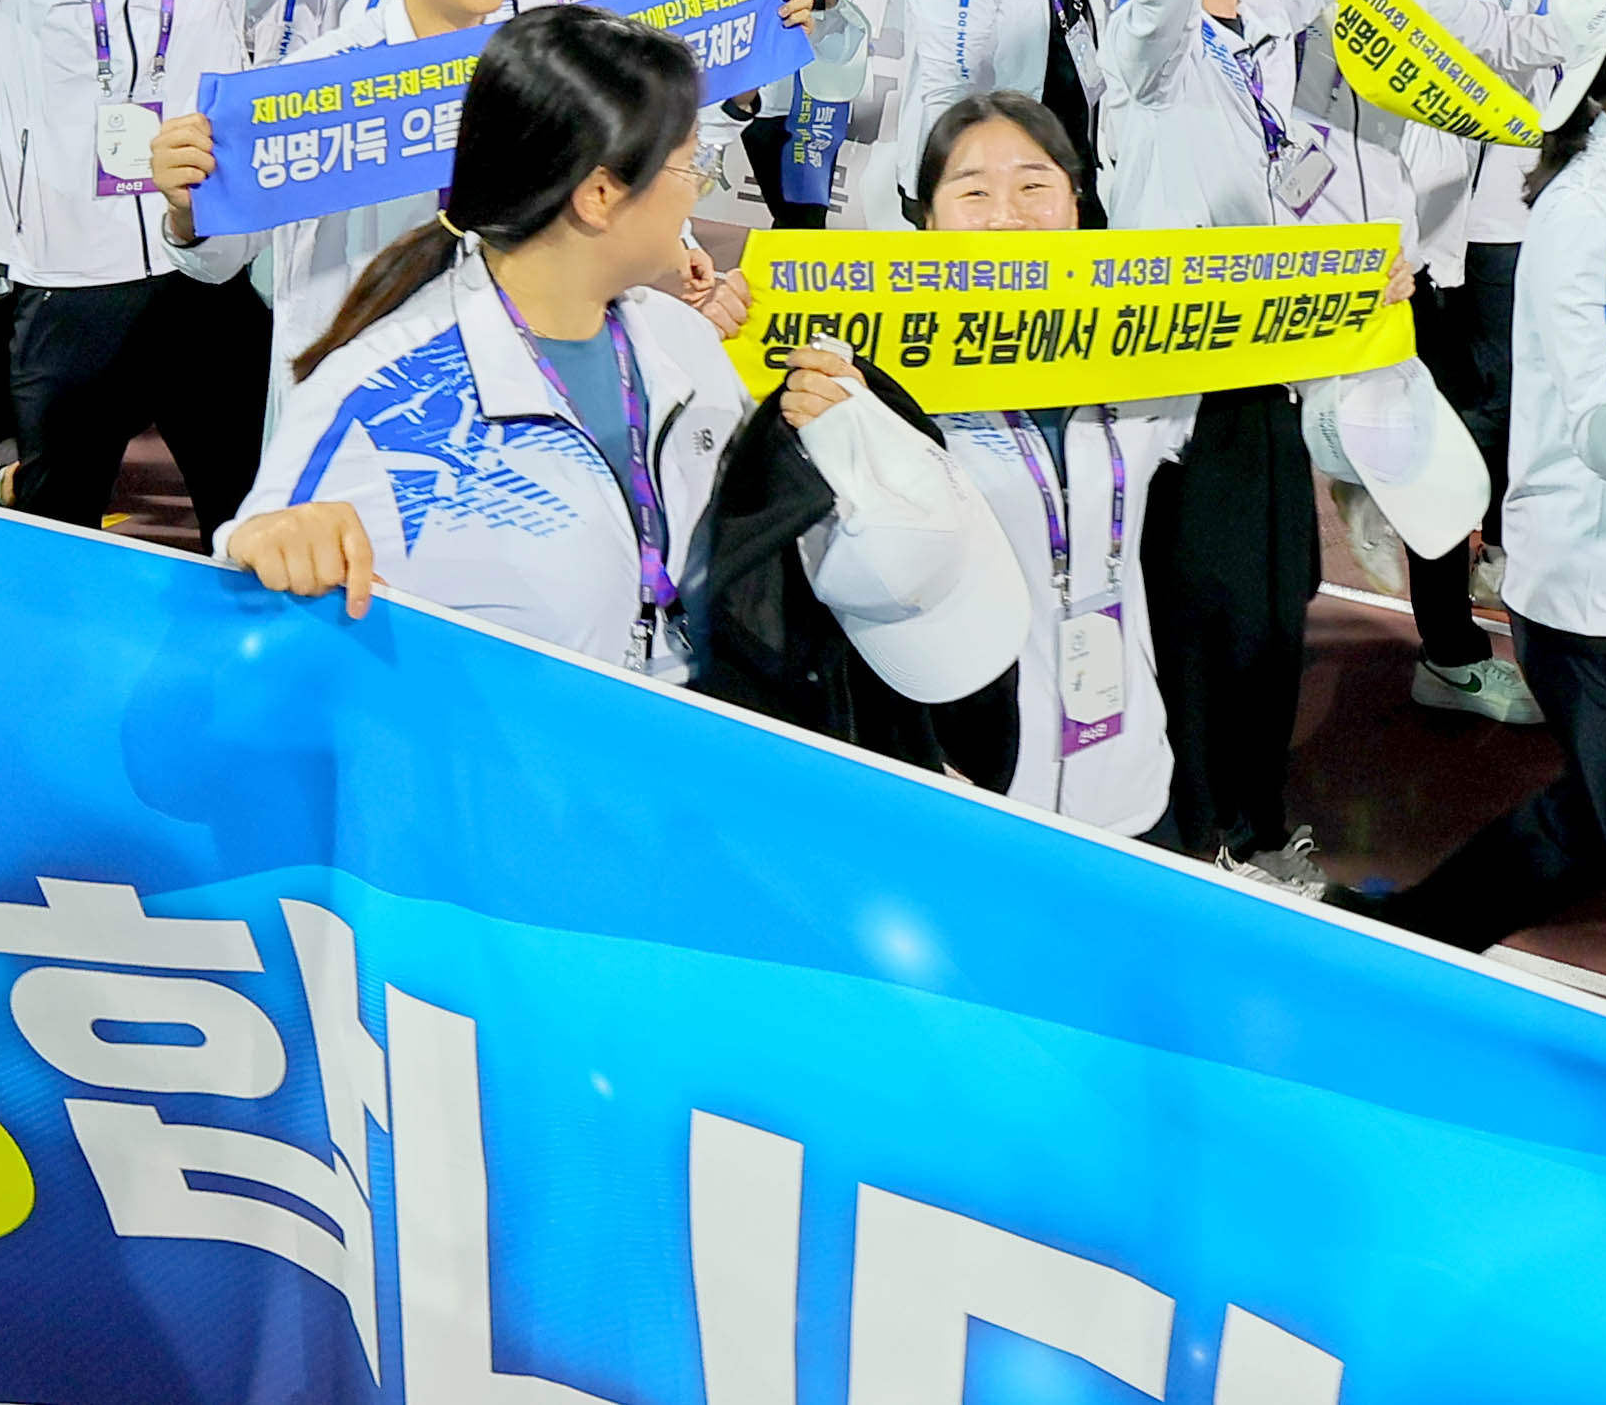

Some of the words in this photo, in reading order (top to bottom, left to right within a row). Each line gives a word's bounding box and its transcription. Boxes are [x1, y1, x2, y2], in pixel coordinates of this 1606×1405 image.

[685, 12, 756, 74] 국체전
[1332, 4, 1395, 73] 생명의
[1388, 56, 1421, 94] 땅
[1409, 25, 1491, 106] 전국체육대회
[251, 84, 343, 124] 제104회
[251, 116, 389, 189] 생명가득
[769, 260, 875, 293] 제104회
[888, 259, 1049, 292] 전국체육대회
[1090, 256, 1173, 288] 제43회
[1181, 248, 1387, 285] 전국장애인체육대회
[899, 311, 939, 368] 땅
[952, 307, 1100, 367] 전남에서
[1110, 301, 1243, 358] 하나되는
[1250, 289, 1382, 345] 대한민국
